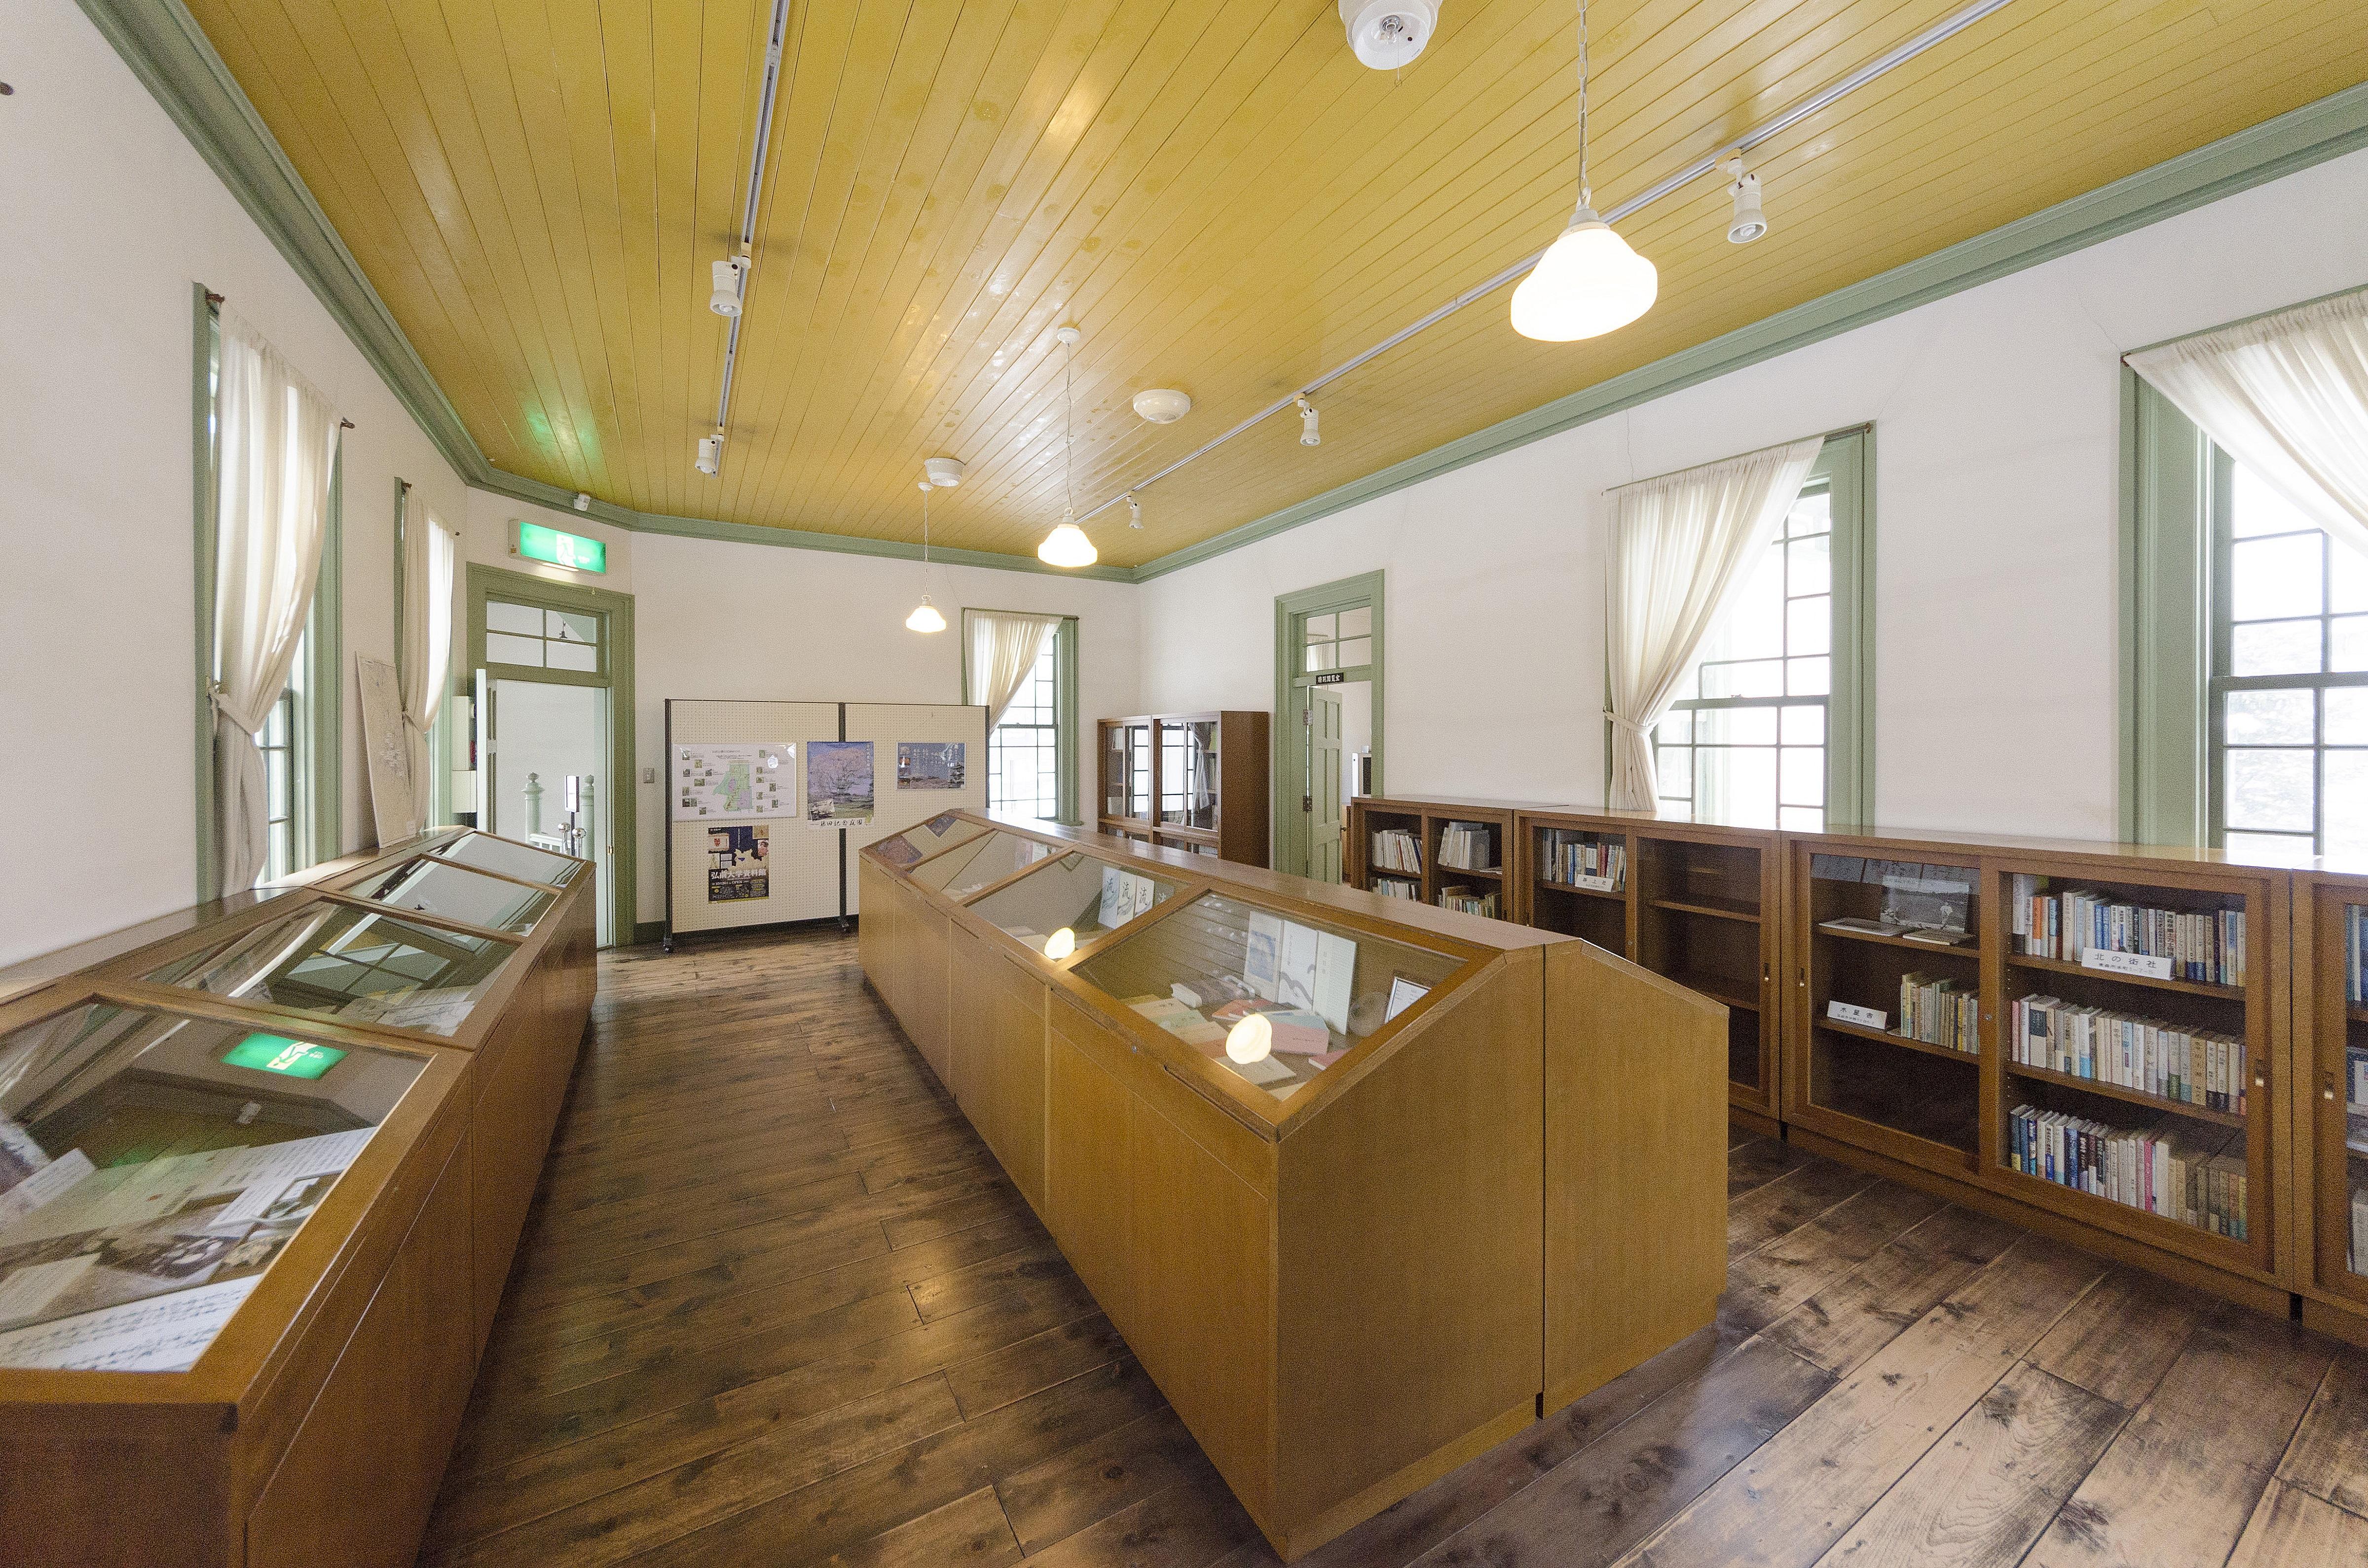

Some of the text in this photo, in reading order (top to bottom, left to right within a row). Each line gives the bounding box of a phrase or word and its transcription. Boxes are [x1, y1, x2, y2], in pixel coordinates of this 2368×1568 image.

[711, 869, 766, 879] 弘前大学資料館
[2094, 953, 2156, 969] 北の街社
